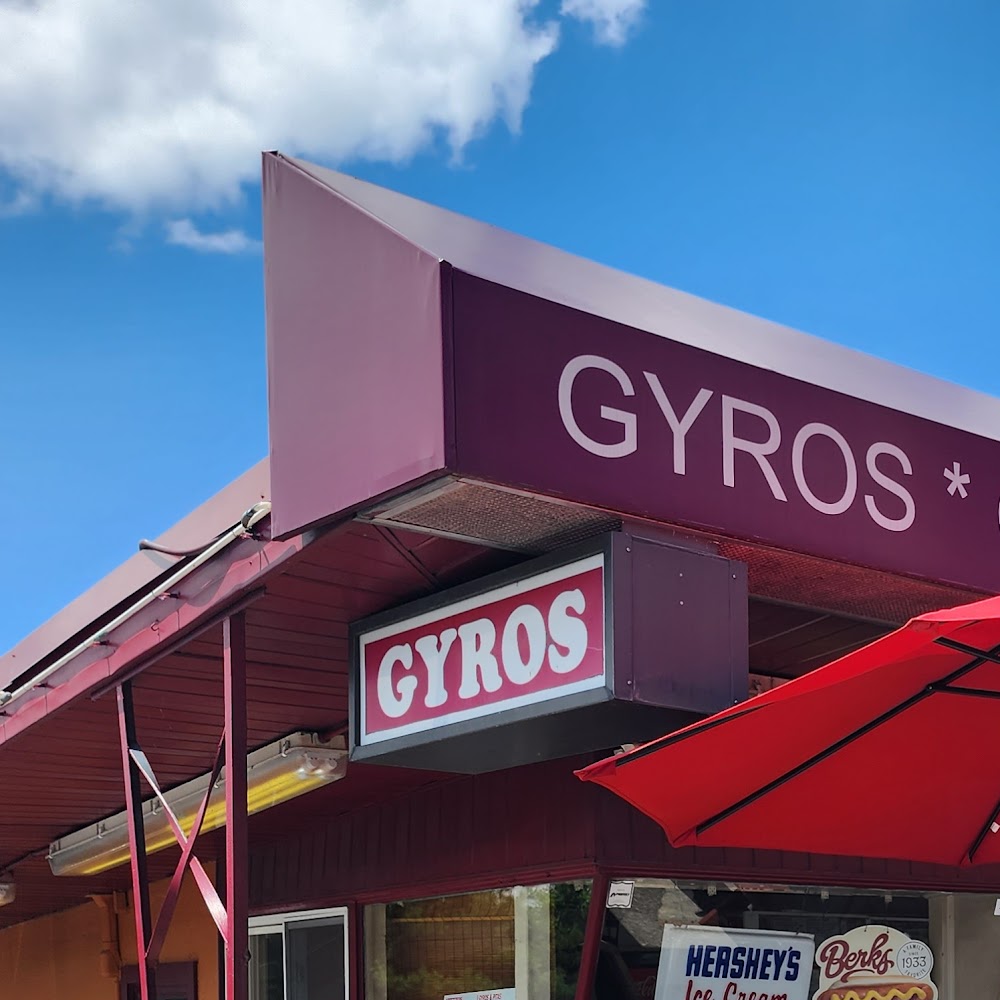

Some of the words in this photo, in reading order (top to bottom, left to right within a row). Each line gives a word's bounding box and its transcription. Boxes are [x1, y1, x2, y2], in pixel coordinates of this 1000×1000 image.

[558, 355, 916, 532] GYROS
[377, 588, 588, 718] GYROS
[685, 945, 801, 981] HERSHEY'S
[820, 933, 895, 983] Berks
[902, 956, 926, 968] 1933
